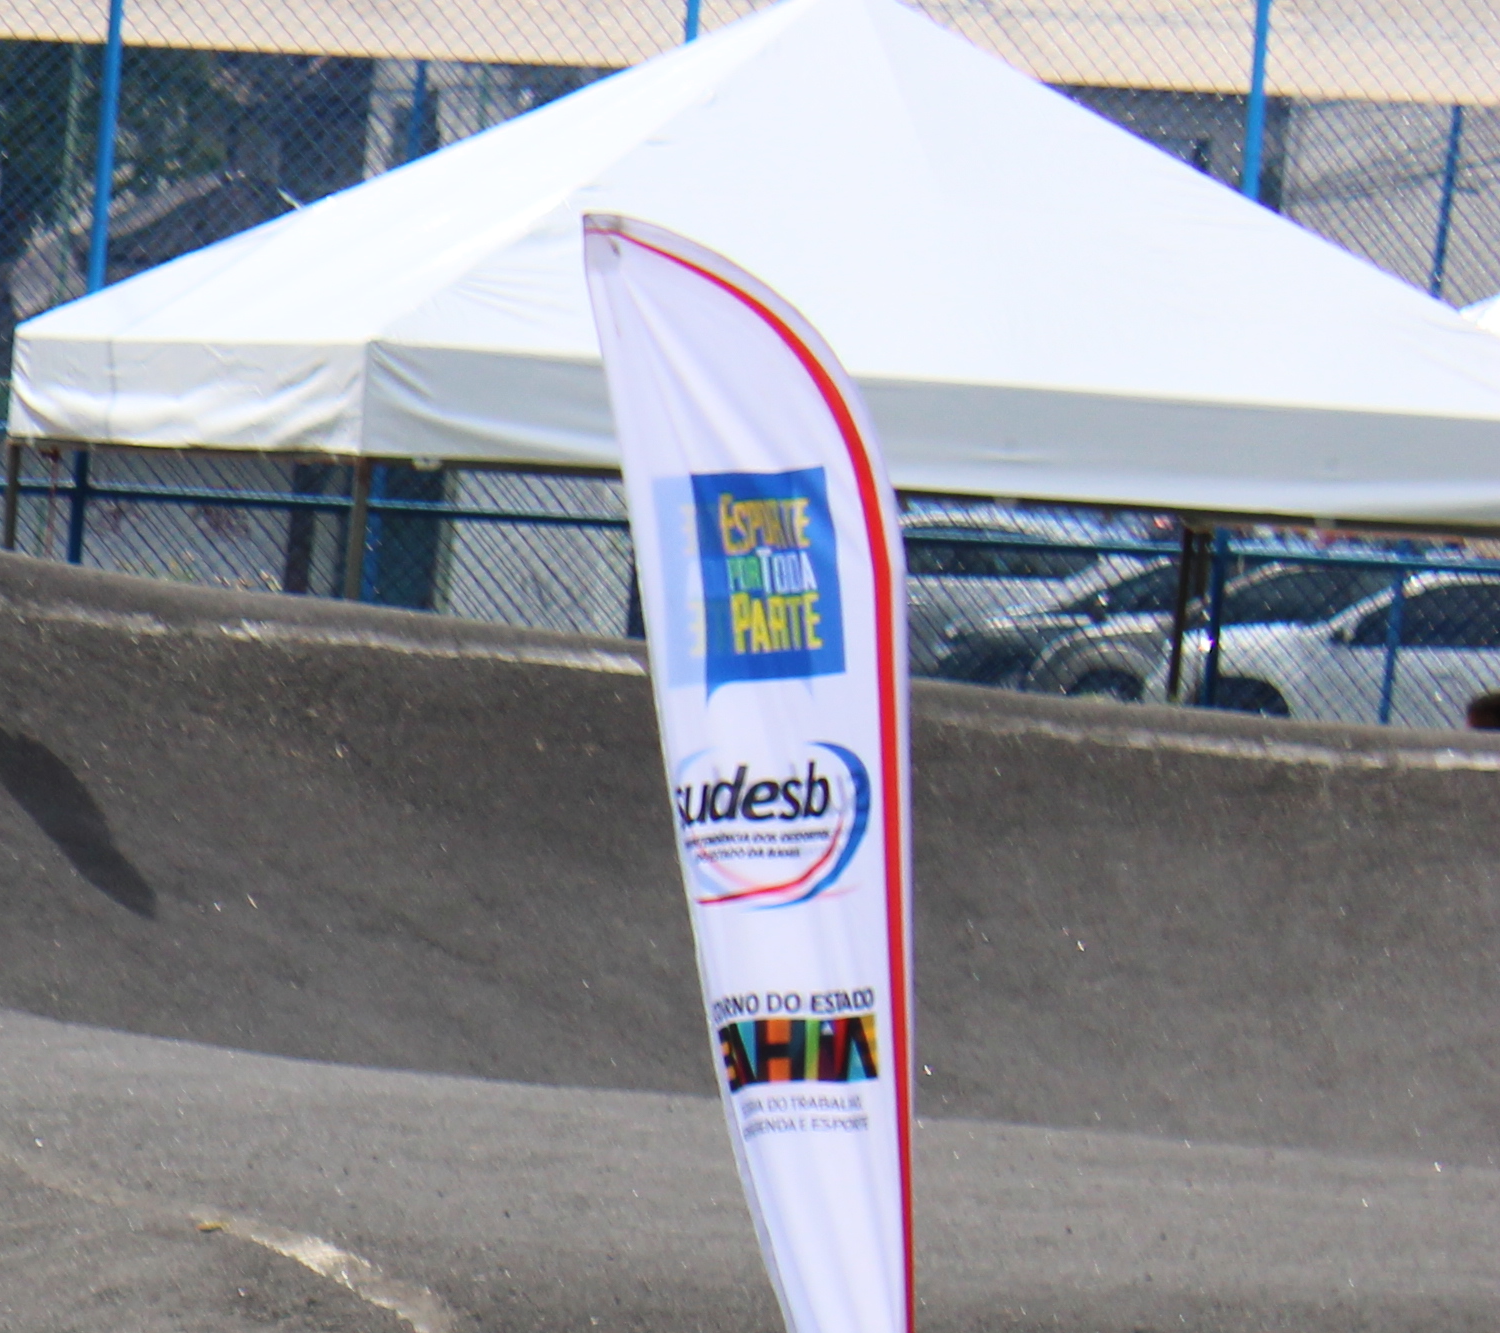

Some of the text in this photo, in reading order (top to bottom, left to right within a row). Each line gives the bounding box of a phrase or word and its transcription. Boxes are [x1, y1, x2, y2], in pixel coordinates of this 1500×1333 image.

[731, 590, 824, 655] PARTE
[766, 993, 801, 1013] DO
[811, 988, 875, 1013] ESTADO
